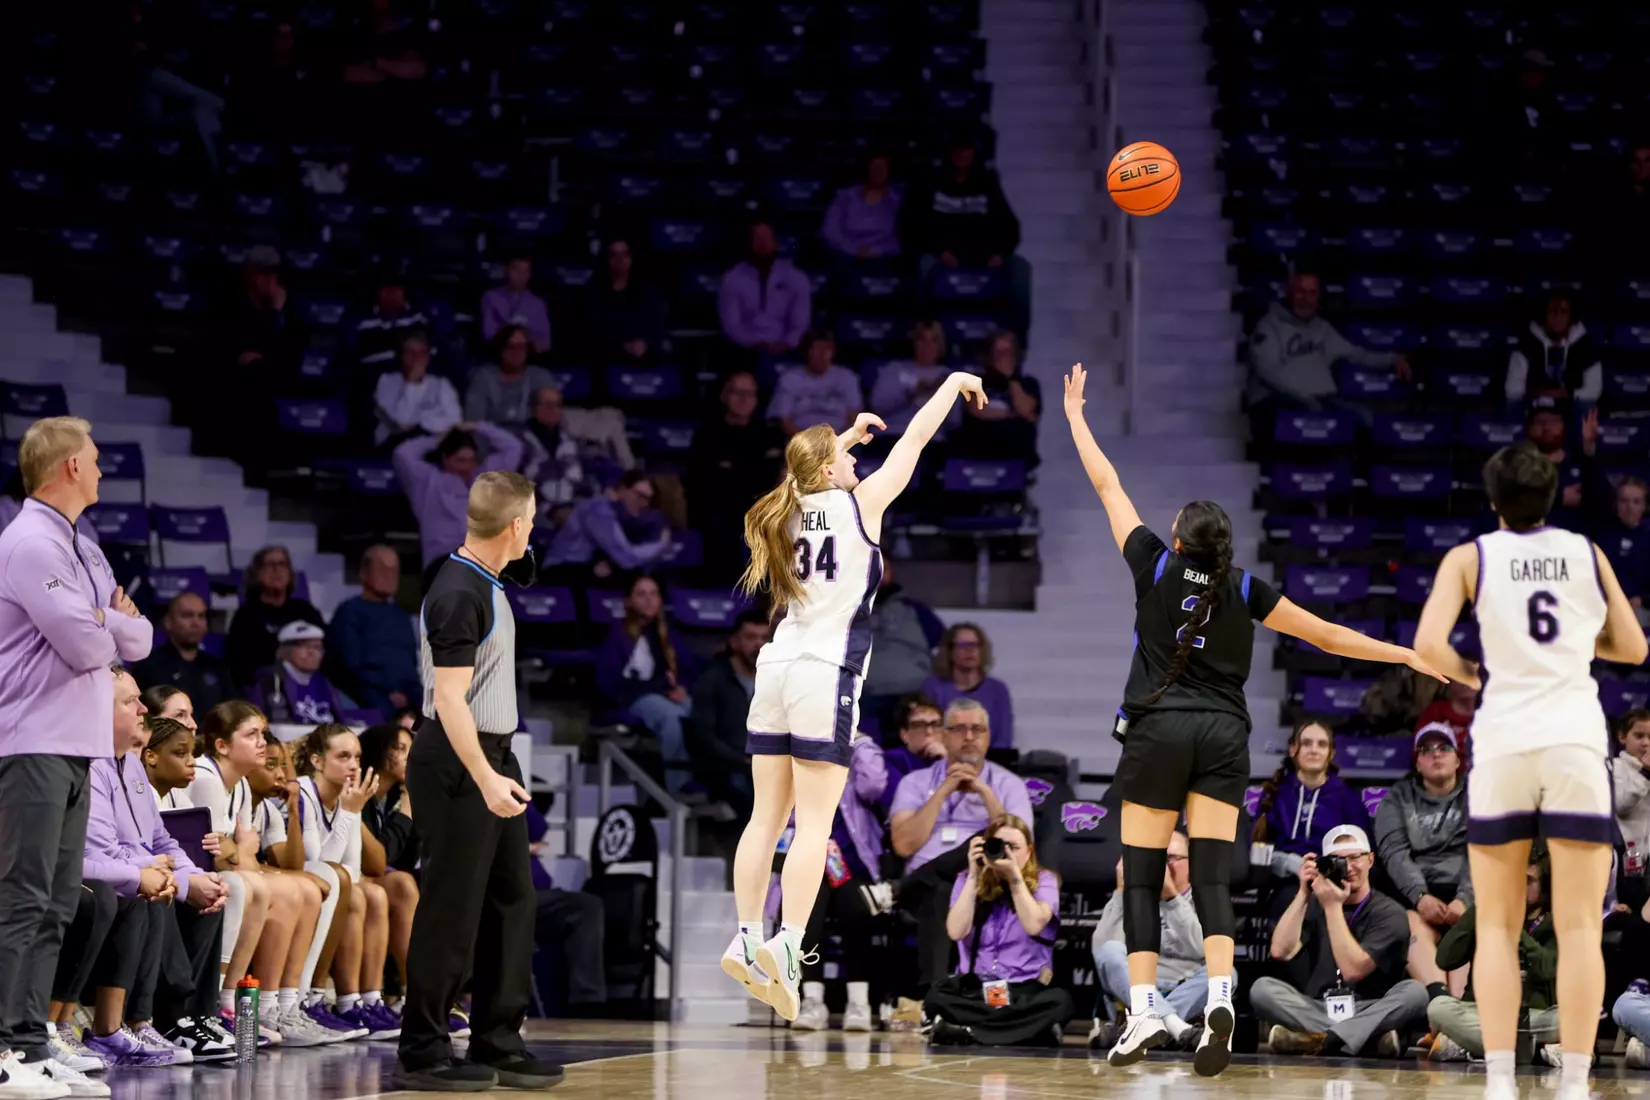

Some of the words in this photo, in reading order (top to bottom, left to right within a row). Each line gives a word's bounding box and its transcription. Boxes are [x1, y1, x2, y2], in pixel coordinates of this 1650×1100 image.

[1120, 163, 1160, 182] ELITE
[801, 510, 831, 531] HEAL
[793, 535, 839, 583] 34
[1510, 557, 1570, 582] GARCIA
[1176, 595, 1212, 648] 2
[1527, 590, 1560, 645] 6
[1333, 1003, 1345, 1014] M
